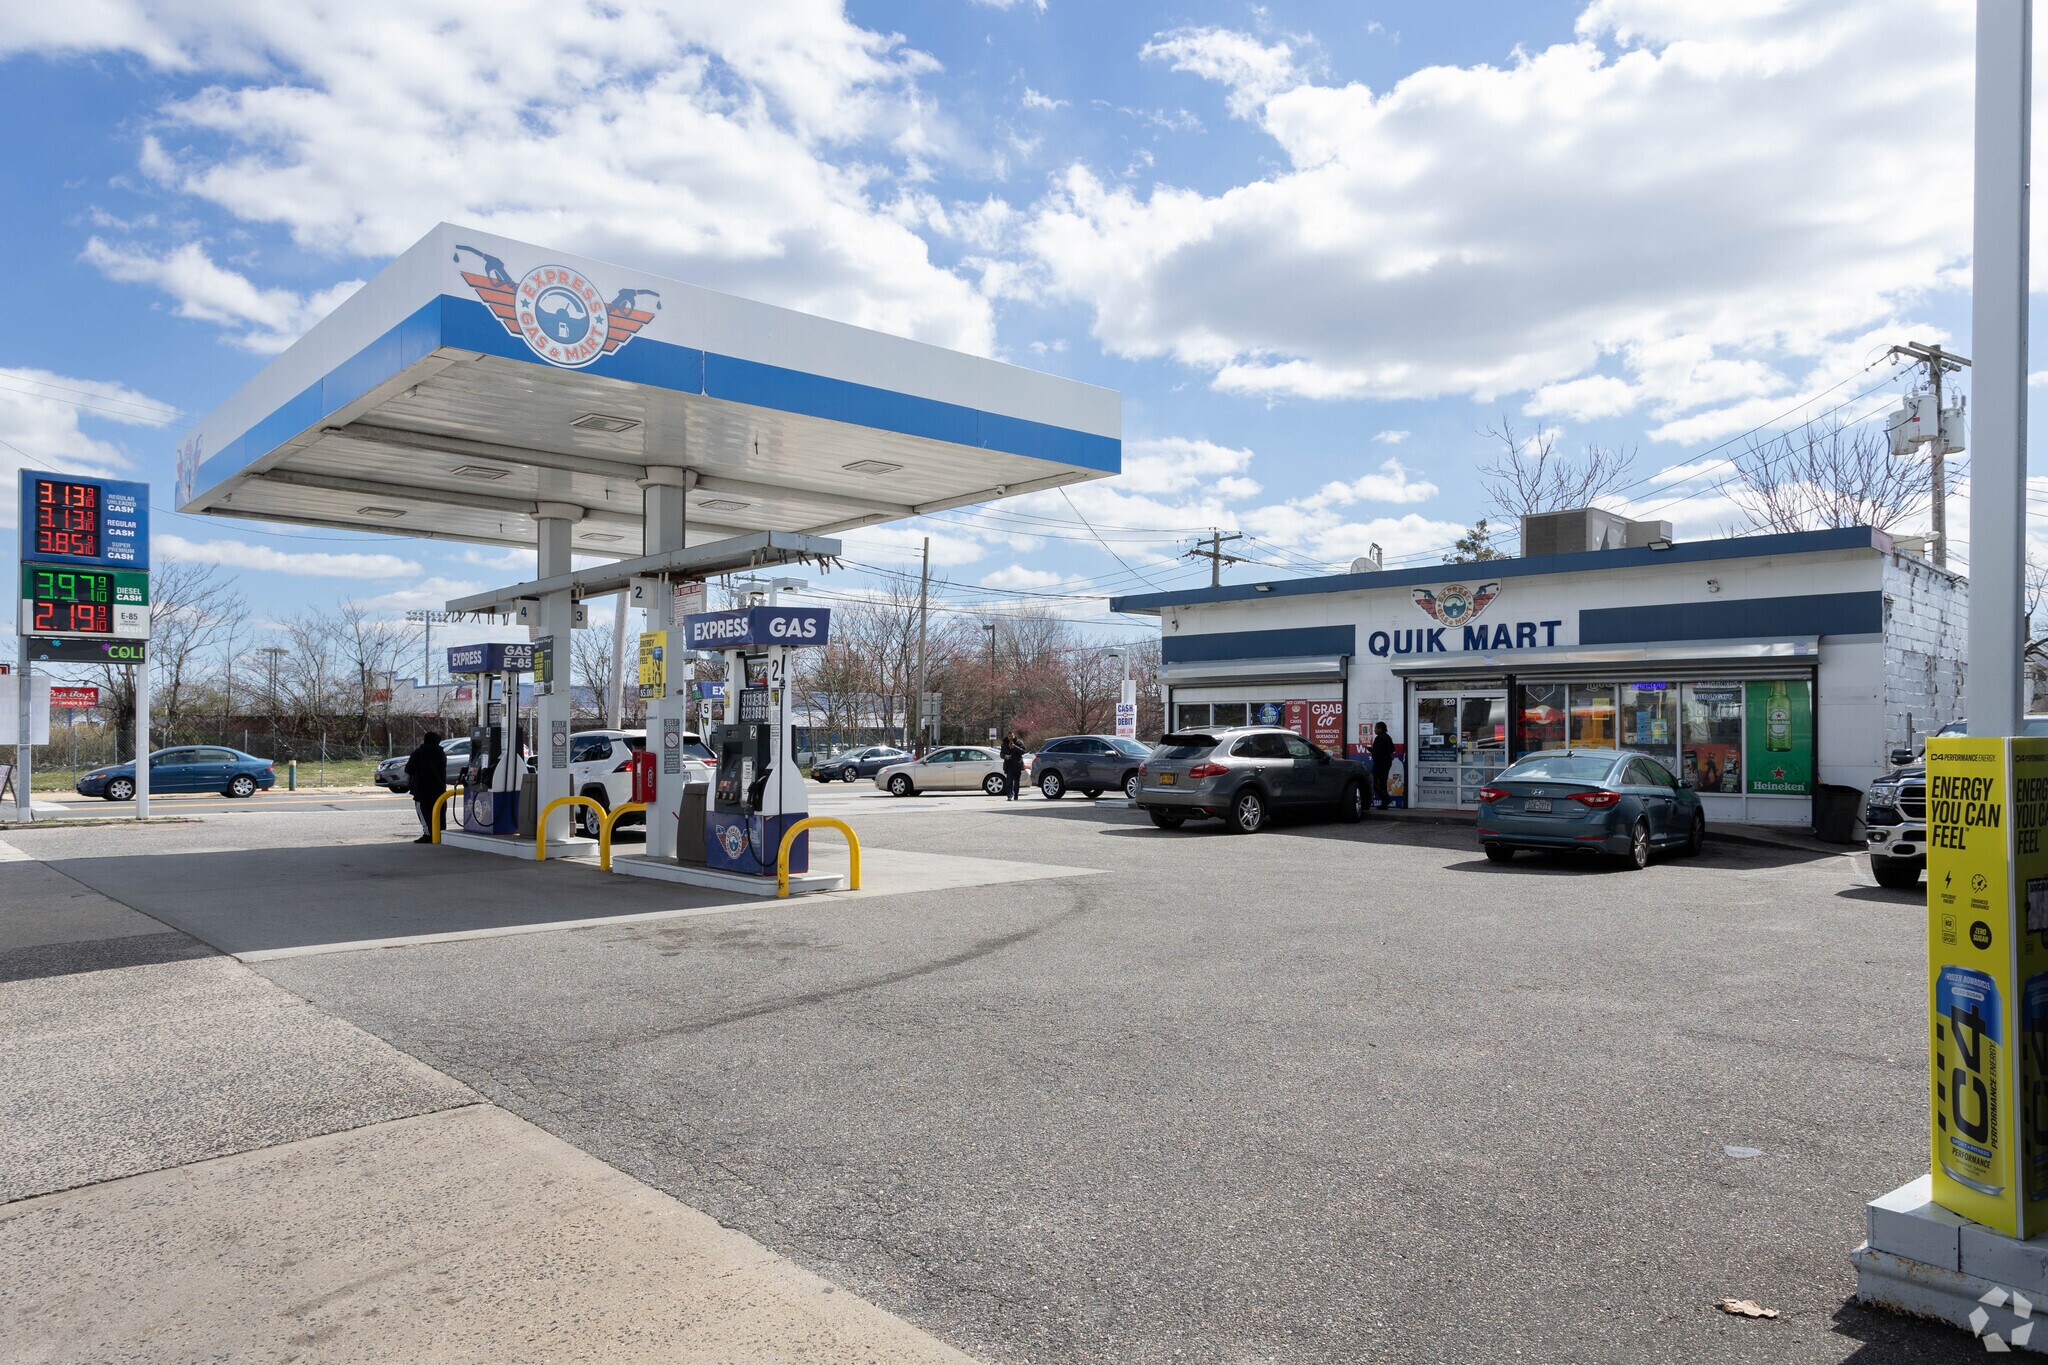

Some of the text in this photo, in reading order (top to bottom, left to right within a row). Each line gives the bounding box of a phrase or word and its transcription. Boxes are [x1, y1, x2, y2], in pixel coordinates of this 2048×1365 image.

[521, 270, 603, 313] EXPRESS
[519, 311, 606, 362] GAS & MART
[106, 499, 136, 508] UNLEADED
[108, 494, 135, 502] REGULAR
[108, 504, 134, 514] CASH
[107, 519, 136, 529] REGULAR
[108, 528, 134, 537] CASH
[108, 546, 134, 554] PREMIUM
[108, 552, 134, 561] CASH
[116, 586, 142, 596] DIESEL
[116, 593, 142, 602] CASH
[635, 586, 643, 599] 2
[1438, 586, 1472, 604] EXPRESS
[120, 612, 138, 621] E-85
[520, 606, 527, 618] 4
[576, 610, 583, 622] 3
[1436, 608, 1449, 625] GAS
[1455, 607, 1473, 626] MART
[116, 626, 142, 634] CASH
[694, 617, 748, 641] EXPRESS
[769, 617, 817, 638] GAS
[1368, 620, 1562, 658] QUIK MART
[504, 645, 532, 656] GAS
[452, 650, 482, 667] EXPRESS
[503, 658, 532, 668] E-85
[772, 660, 779, 682] 2
[640, 688, 653, 698] $5.00
[703, 704, 709, 714] 5
[1312, 704, 1342, 714] GRAB
[1317, 714, 1336, 727] Go
[751, 726, 756, 740] 2
[1753, 781, 1805, 791] Heineken
[1932, 776, 1994, 801] ENERGY
[1932, 800, 2001, 828] YOU CAN
[2016, 803, 2036, 828] YOU
[1932, 824, 1966, 850] FEEL
[2017, 830, 2040, 855] FEEL
[1973, 934, 1989, 943] SUGAR
[1944, 973, 1962, 982] FROZEN
[1963, 976, 1991, 990] BOMBSICLE
[1950, 1004, 1988, 1144] C4
[1989, 1042, 1998, 1150] PERFORMANCE ENERGY
[1952, 1147, 1991, 1169] PERFORMANCE
